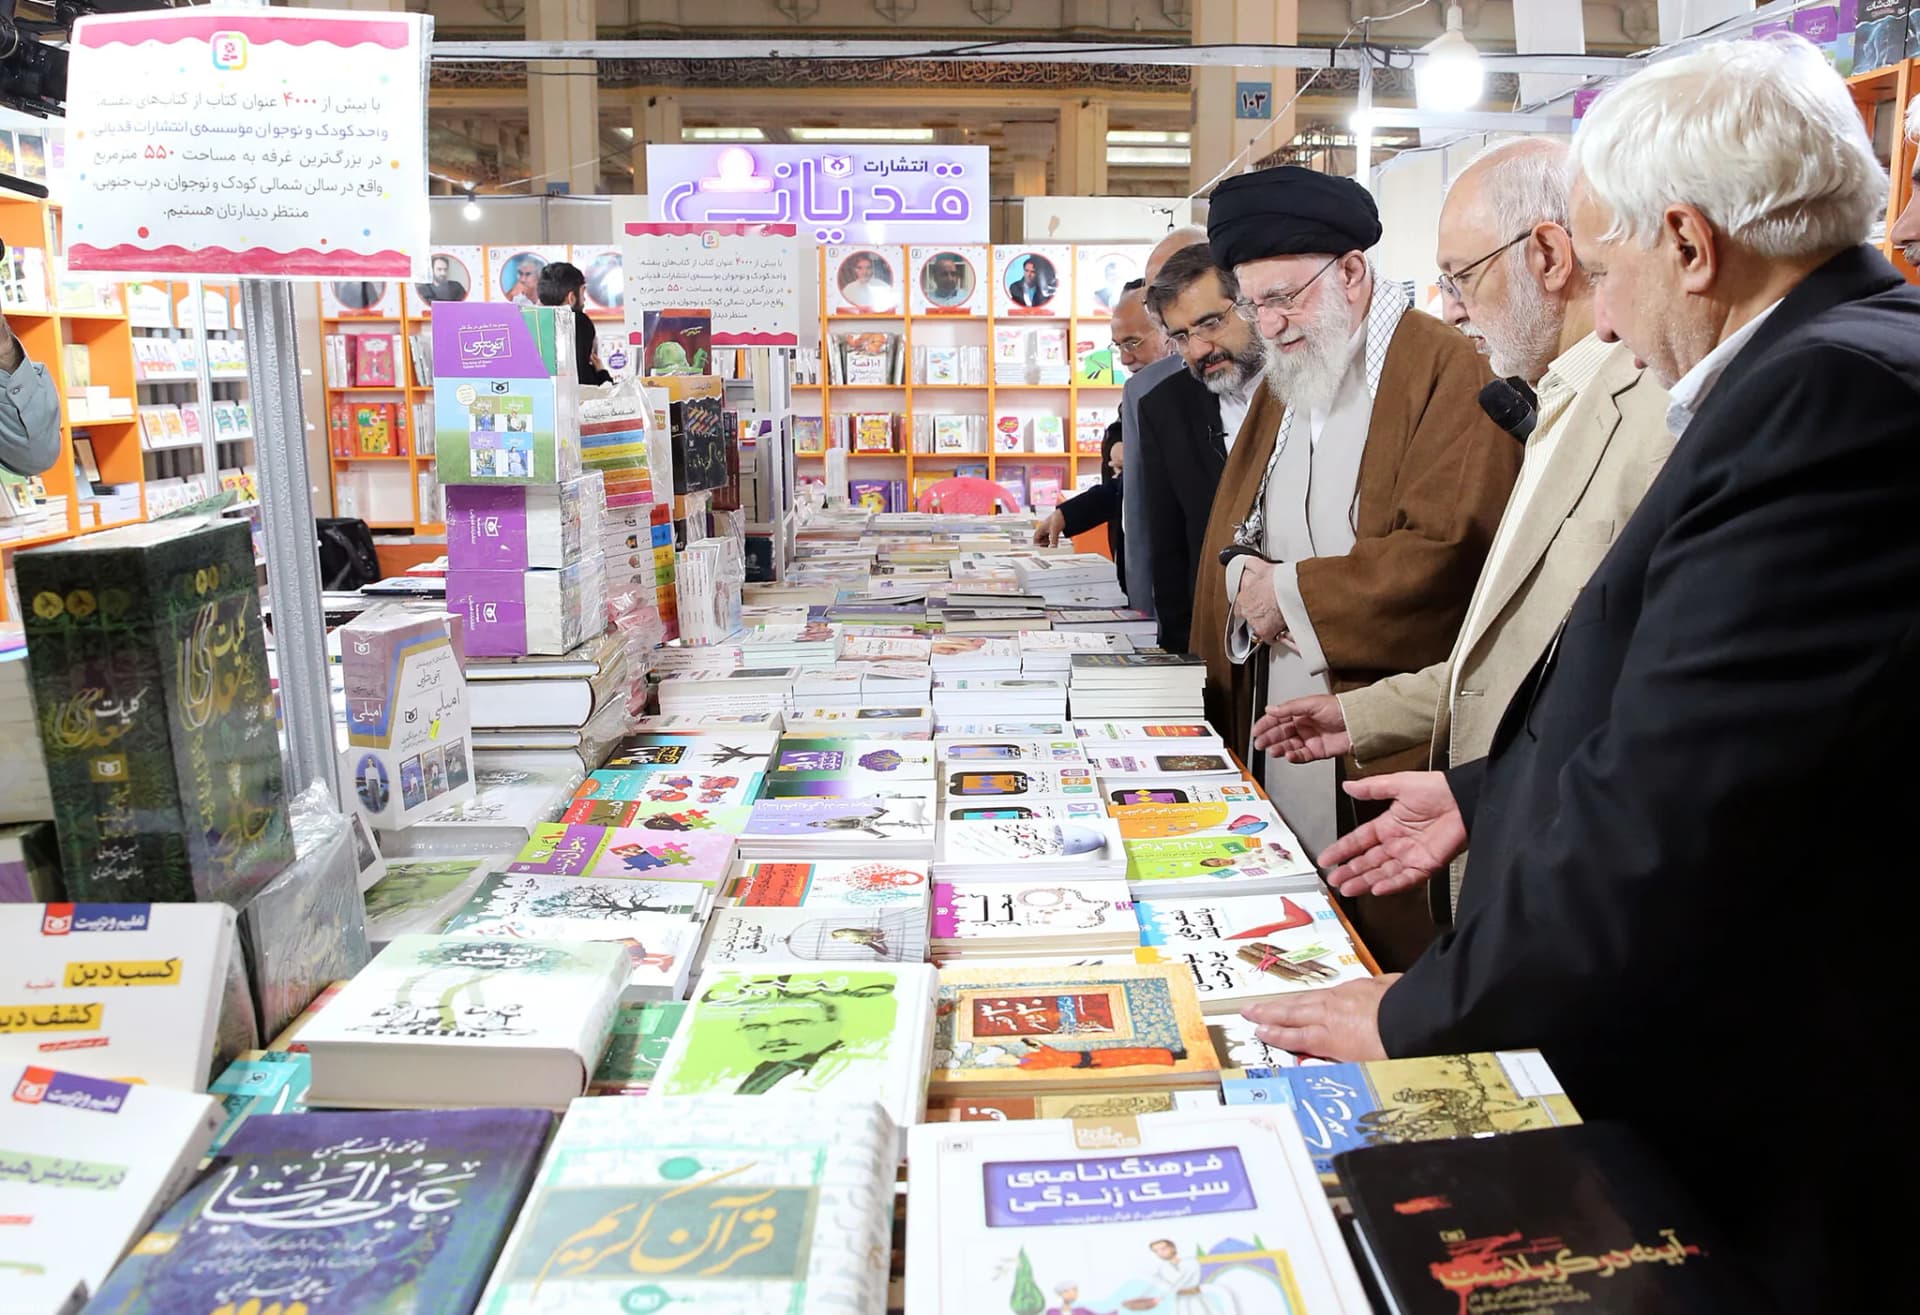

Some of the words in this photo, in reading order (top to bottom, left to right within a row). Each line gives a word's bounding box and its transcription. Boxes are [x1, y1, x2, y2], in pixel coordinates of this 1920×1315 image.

[193, 92, 202, 110] از
[206, 92, 237, 110] کتاب
[242, 93, 277, 110] عنوان
[283, 91, 317, 107] ۴۰۰۰
[321, 95, 331, 112] از
[335, 97, 367, 113] بیش
[371, 96, 381, 114] با
[1241, 91, 1267, 112] ۱۰۳
[134, 120, 188, 136] انتشارات
[255, 122, 303, 139] نوجوان
[305, 128, 313, 139] و
[314, 124, 354, 140] کودک
[355, 127, 389, 141] واحد
[144, 144, 174, 159] ۵۵۰
[182, 147, 236, 161] مساحت
[243, 155, 256, 166] به
[262, 149, 292, 167] غرفه
[368, 154, 382, 169] در
[863, 156, 929, 177] انتشارات
[134, 178, 160, 191] درب
[212, 181, 219, 192] و
[221, 176, 257, 193] کودک
[260, 177, 302, 194] شمالی
[304, 177, 338, 195] سالن
[340, 181, 354, 196] در
[356, 179, 383, 197] واقع
[660, 158, 973, 244] قدیانی
[163, 205, 215, 220] هستیم.
[217, 203, 268, 220] دیدارتان
[271, 203, 309, 221] منتظر
[352, 702, 383, 722] امیلی
[71, 964, 113, 988] دین
[118, 956, 179, 987] کسب
[0, 1011, 28, 1035] دی
[32, 1002, 97, 1026] کشف
[29, 1158, 100, 1188] ستایش
[1008, 1184, 1124, 1213] زندگی
[1128, 1179, 1230, 1203] سبک
[532, 1162, 758, 1306] کریم
[629, 1190, 777, 1275] قرآن
[1631, 1229, 1686, 1266] آینه
[1439, 1252, 1593, 1290] کربلاست
[1600, 1247, 1632, 1277] در
